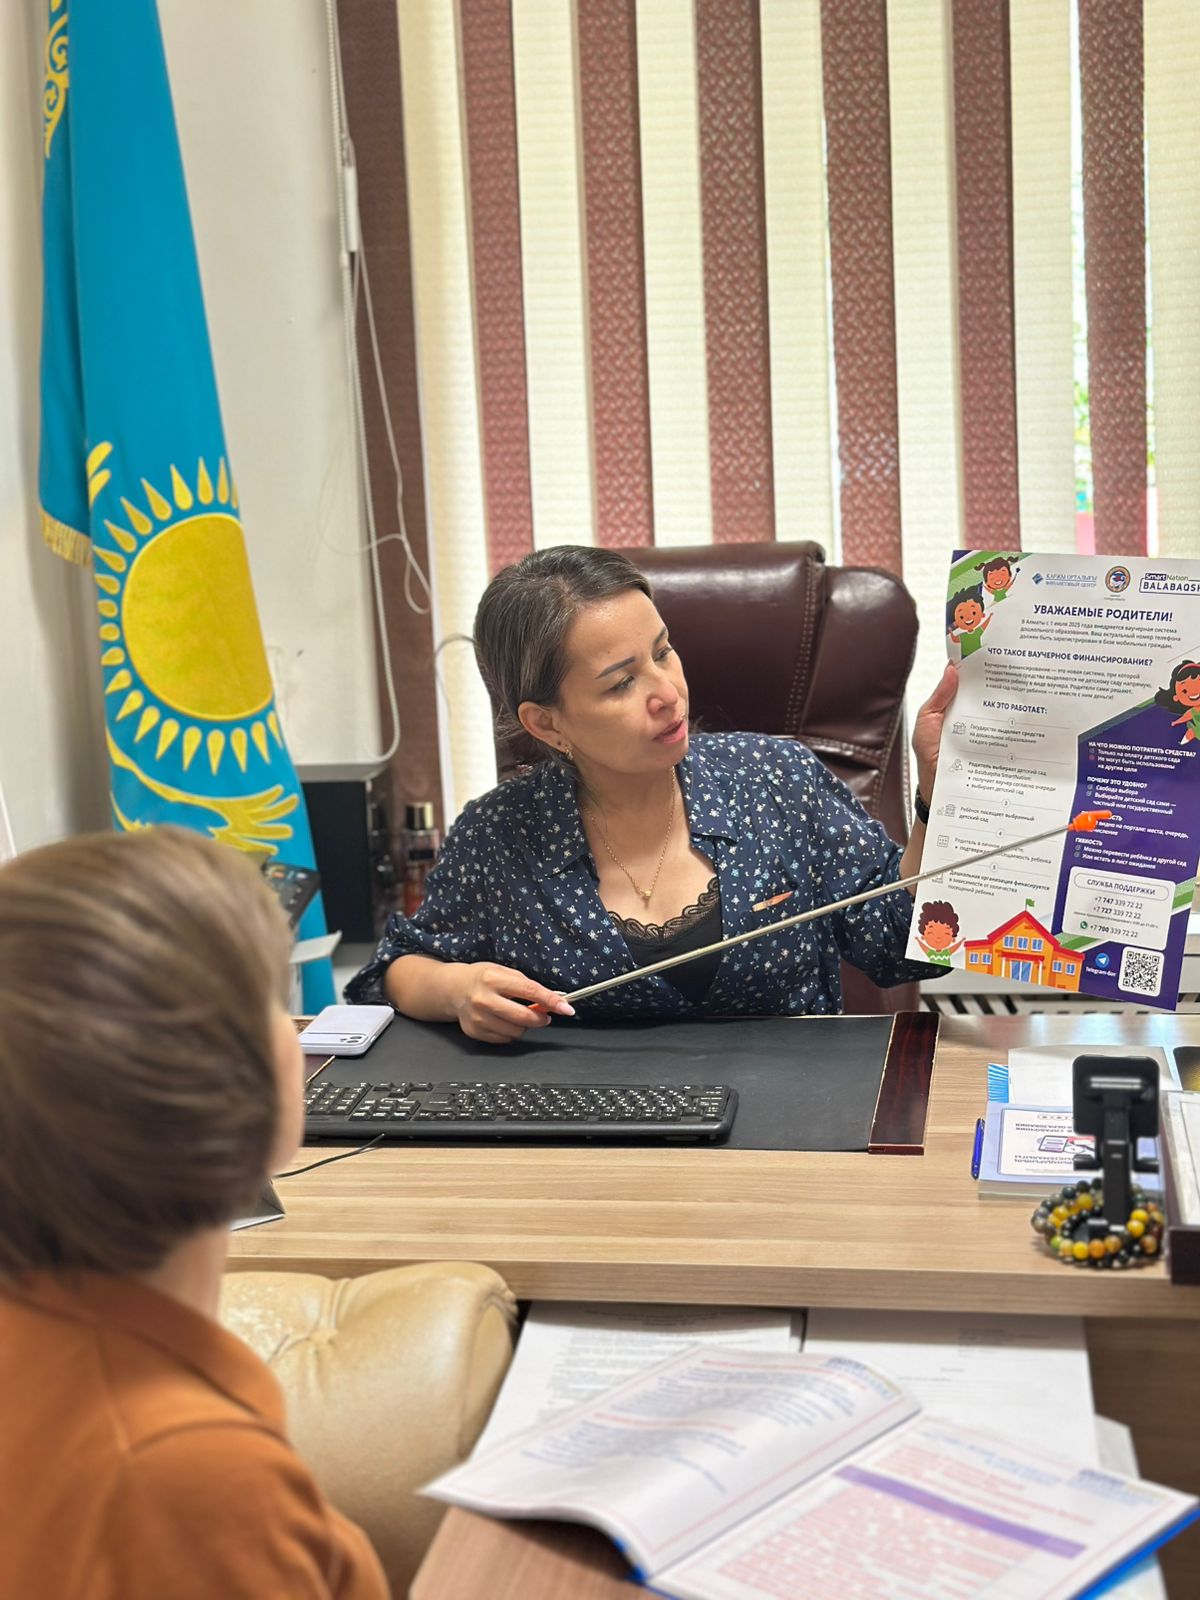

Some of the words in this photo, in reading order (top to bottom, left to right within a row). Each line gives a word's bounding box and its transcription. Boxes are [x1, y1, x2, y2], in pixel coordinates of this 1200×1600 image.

[1034, 605, 1103, 617] УВАЖАЕМЫЕ
[1106, 609, 1173, 622] РОДИТЕЛИ!
[1054, 636, 1097, 644] зарегистрирован
[1004, 649, 1026, 657] ТАКОЕ
[1028, 651, 1070, 660] ВАУЧЕРНОЕ
[1073, 654, 1153, 666] ФИНАНСИРОВАНИЕ?
[1009, 664, 1050, 672] финансирование
[983, 700, 995, 708] КАК
[1011, 703, 1047, 714] РАБОТАЕТ:
[1132, 746, 1163, 754] ПОТРАТИТЬ
[1165, 749, 1196, 757] СРЕДСТВА?
[1124, 752, 1142, 760] оплату
[1105, 765, 1123, 773] другие
[1136, 761, 1175, 769] использованы
[1087, 776, 1109, 784] ПОЧЕМУ
[1122, 781, 1147, 789] УДОБНО?
[1096, 785, 1117, 793] Свобода
[1095, 792, 1123, 801] Выбирайте
[1124, 796, 1145, 804] детский
[1127, 805, 1173, 815] государственный
[1103, 849, 1129, 858] перевести
[1157, 857, 1176, 865] другой
[1129, 861, 1156, 869] ожидания
[1087, 879, 1113, 888] СЛУЖБА
[1114, 882, 1155, 895] ПОДДЕРЖКИ
[1115, 898, 1126, 906] 339
[1113, 908, 1124, 916] 339
[1098, 925, 1109, 933] 700
